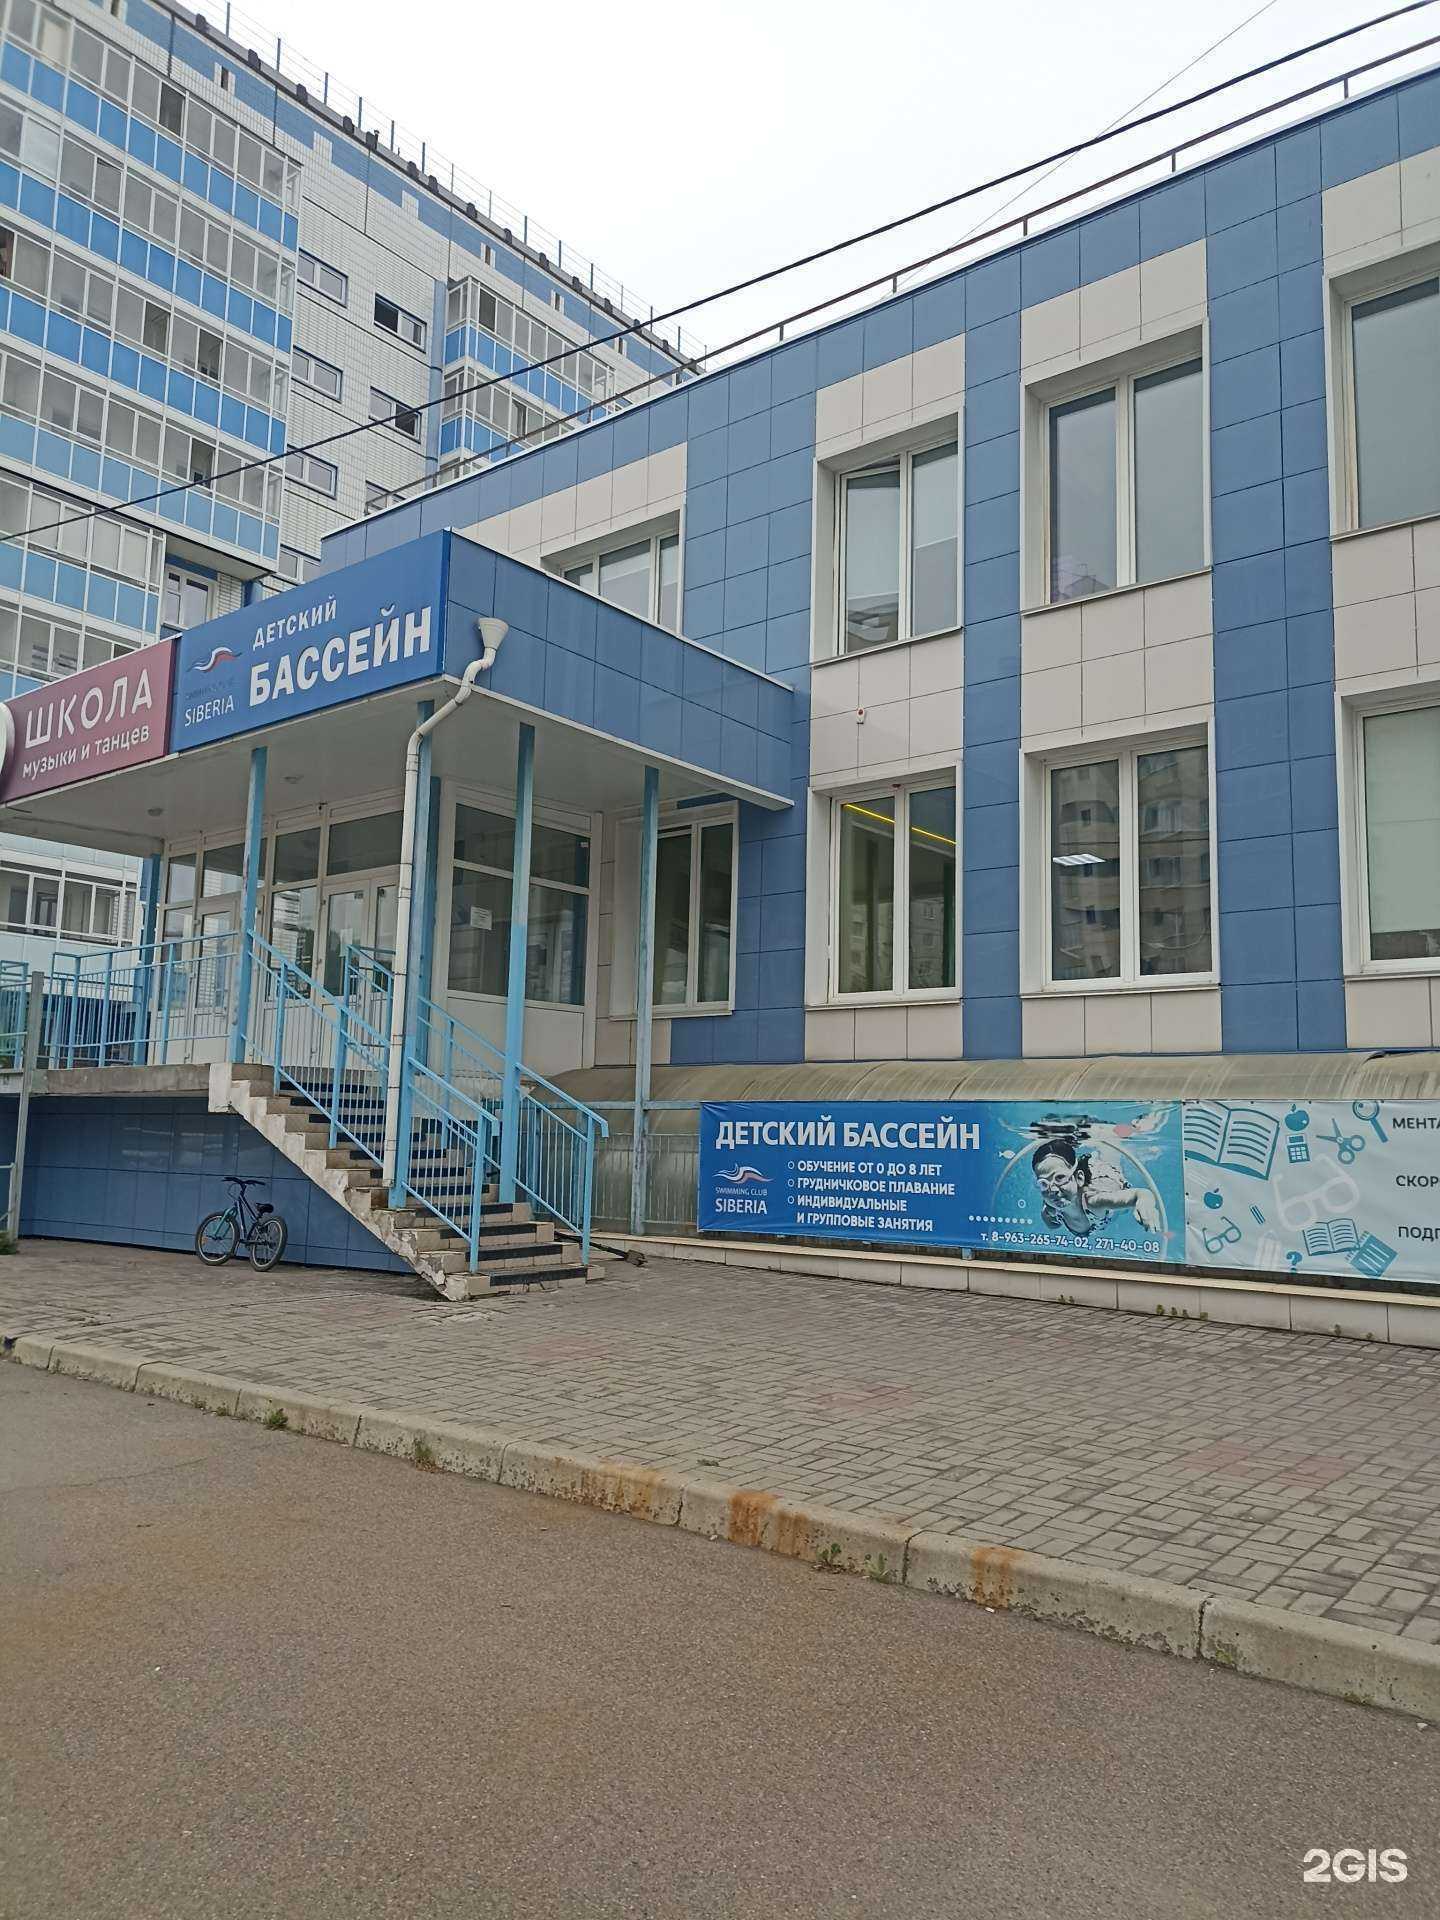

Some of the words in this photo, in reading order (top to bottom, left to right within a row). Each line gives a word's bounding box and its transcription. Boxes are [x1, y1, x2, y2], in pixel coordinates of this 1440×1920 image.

[253, 594, 338, 651] ДЕТСКИЙ
[250, 603, 433, 707] БАССЕЙН
[25, 668, 153, 749] ШКОЛА
[184, 694, 235, 727] SIBERIA
[22, 747, 77, 781] музыки
[81, 744, 90, 760] и
[95, 725, 150, 755] танцев
[715, 1114, 836, 1150] ДЕТСКИЙ
[843, 1115, 980, 1150] БАССЕЙН
[797, 1160, 855, 1173] ОБУЧЕНИЕ
[858, 1162, 874, 1174] ОТ
[876, 1162, 885, 1174] 0
[887, 1163, 906, 1177] ДО
[908, 1163, 917, 1176] 8
[919, 1164, 943, 1177] ЛЕТ
[715, 1186, 750, 1196] SWIMMING
[751, 1188, 768, 1196] CLUB
[797, 1177, 886, 1192] ГРУДНИЧКОВОЕ
[889, 1181, 955, 1196] ПЛАВАНИЕ
[715, 1198, 768, 1215] SIBERIA
[797, 1194, 908, 1212] ИНДИВИДУАЛЬНЫЕ
[796, 1212, 805, 1224] И
[807, 1213, 875, 1228] ГРУППОВЫЕ
[877, 1217, 934, 1232] ЗАНЯТИЯ
[991, 1231, 1092, 1250] 8-963-265-74-02,
[1095, 1238, 1160, 1253] 271-40-08
